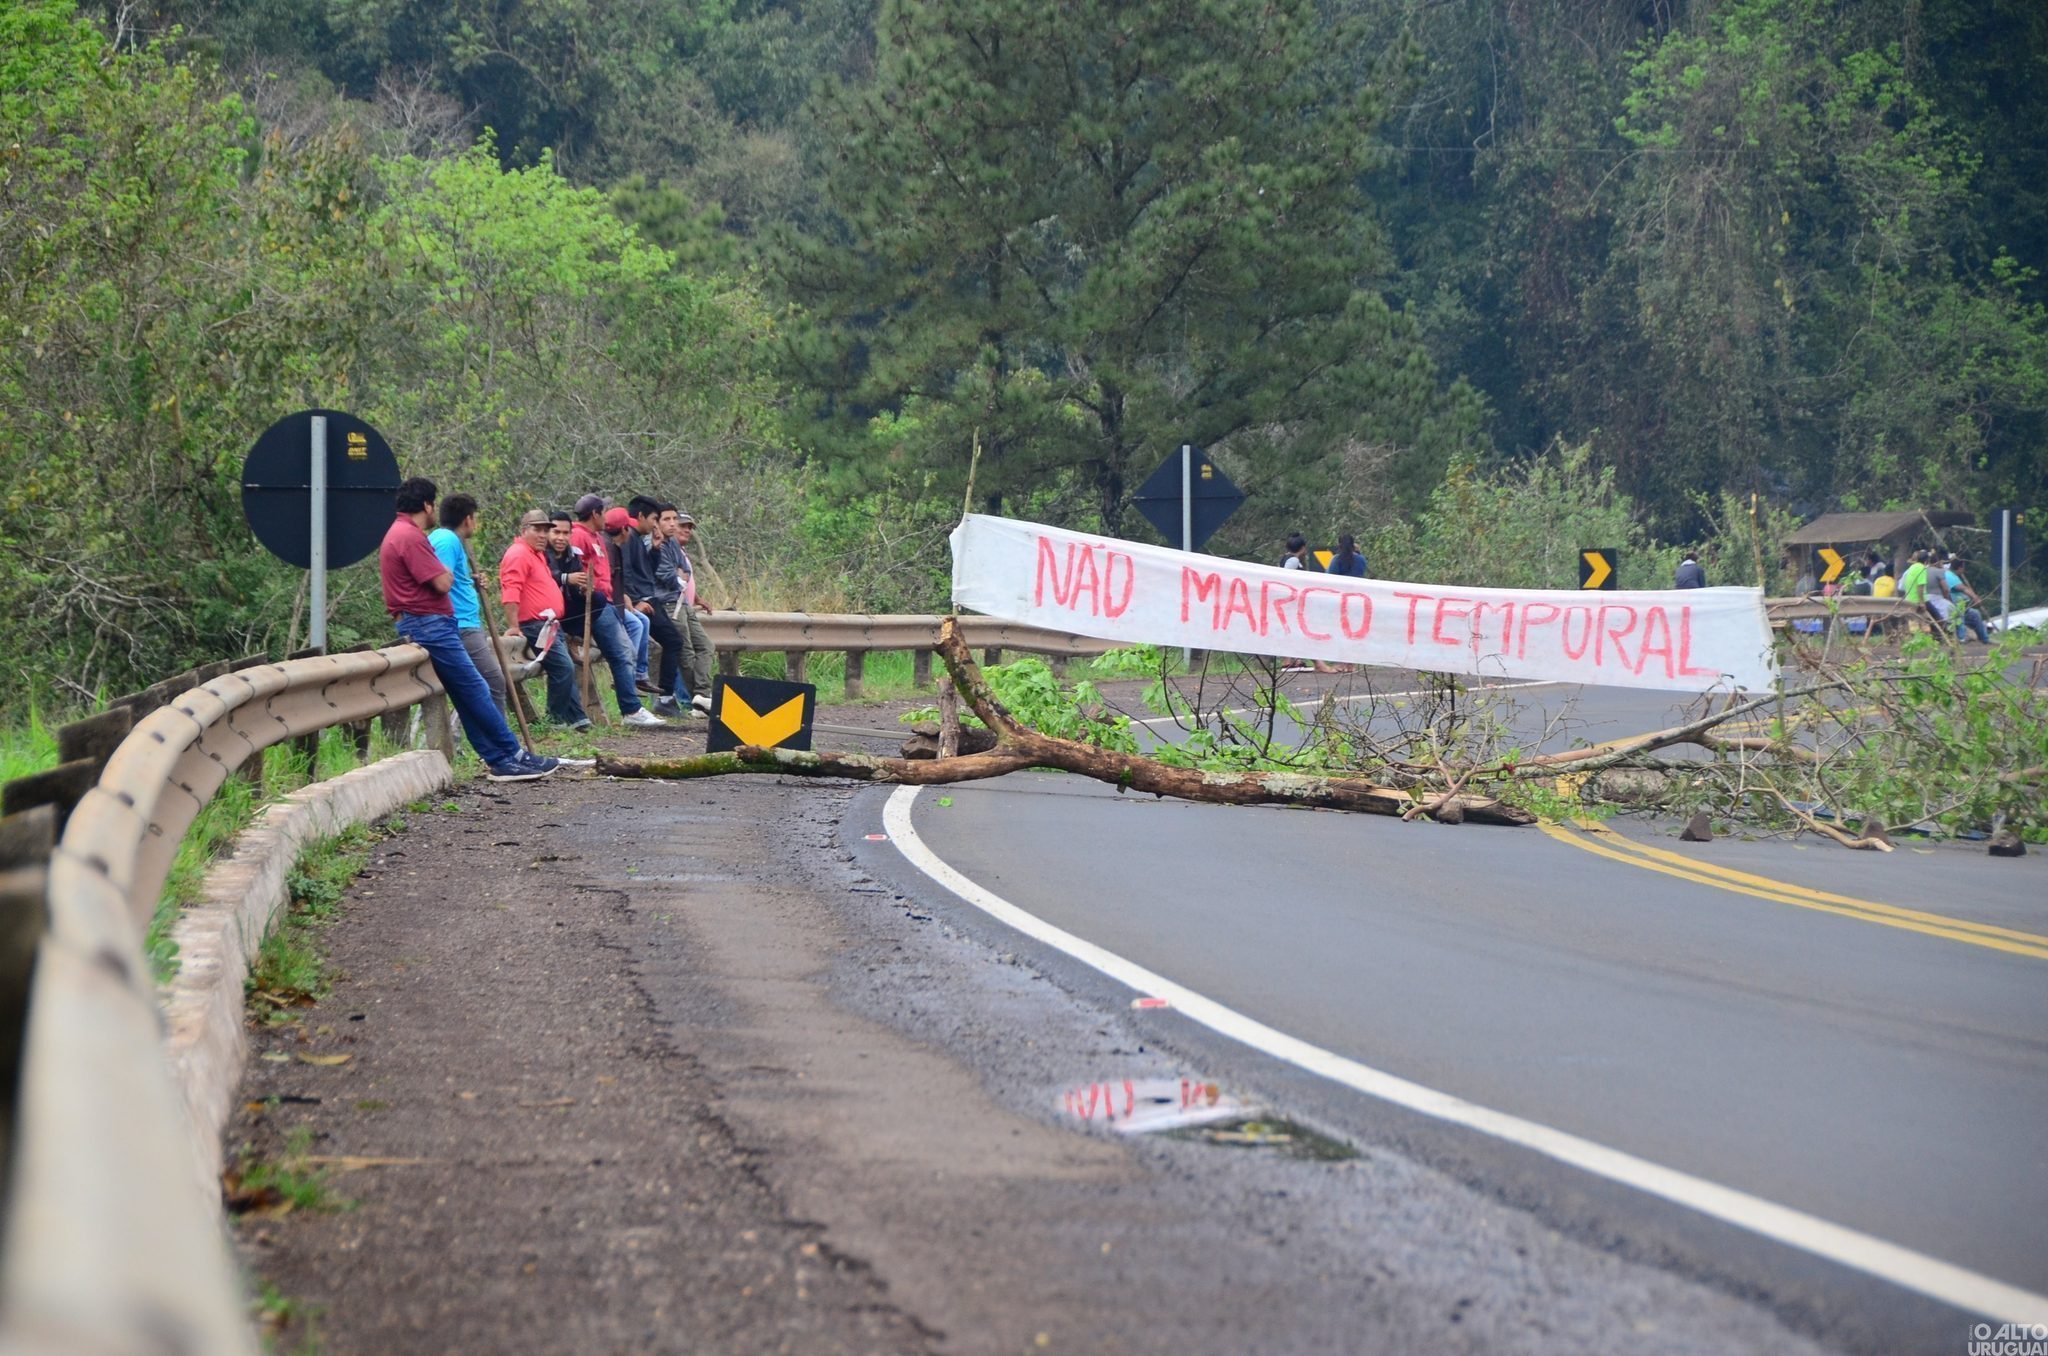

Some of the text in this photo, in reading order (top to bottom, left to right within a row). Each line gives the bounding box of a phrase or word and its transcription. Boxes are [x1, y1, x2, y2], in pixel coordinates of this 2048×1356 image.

[1035, 536, 1721, 679] NÃO MARCO TEMPORAL
